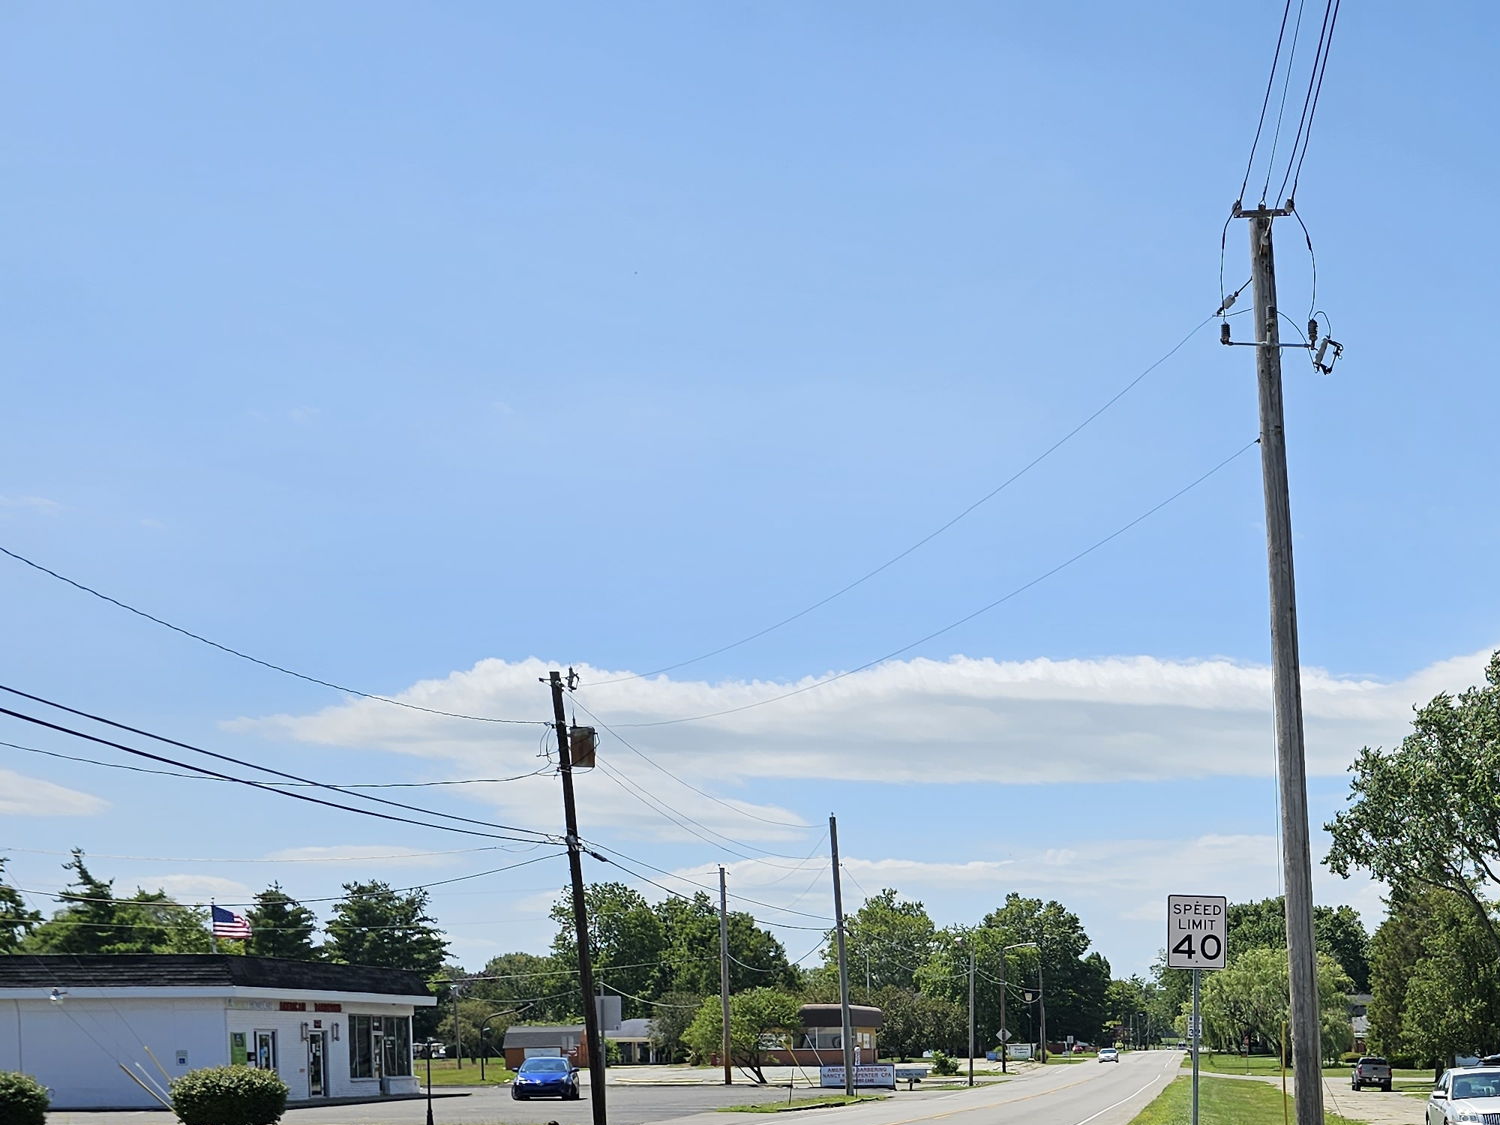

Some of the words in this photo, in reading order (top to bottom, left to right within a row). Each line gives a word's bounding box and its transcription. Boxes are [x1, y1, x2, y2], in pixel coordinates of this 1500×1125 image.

[1173, 903, 1222, 916] SPEED
[1178, 918, 1216, 931] LIMIT
[1171, 933, 1222, 961] 40
